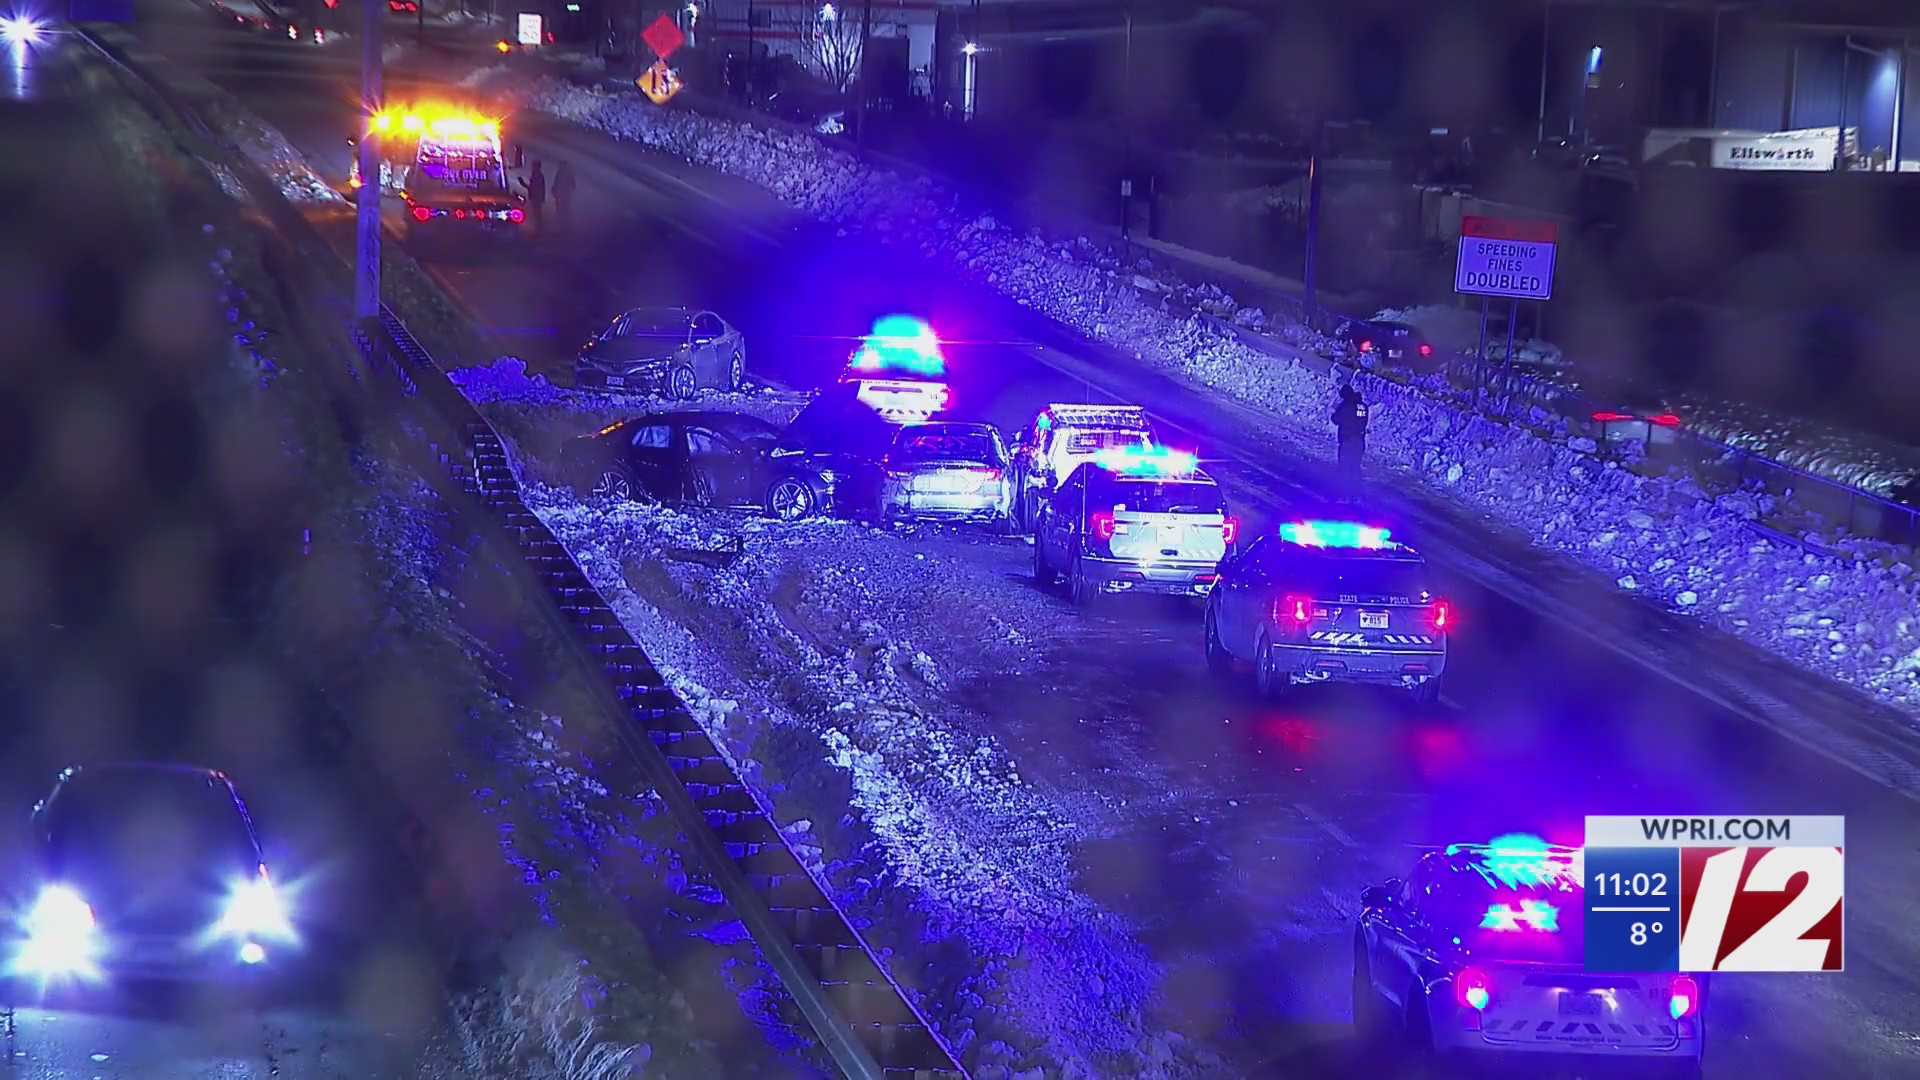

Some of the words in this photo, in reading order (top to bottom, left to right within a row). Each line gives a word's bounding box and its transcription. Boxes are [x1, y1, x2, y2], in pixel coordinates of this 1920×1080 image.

[1478, 243, 1537, 258] SPEEDING
[1487, 258, 1523, 272] FINES
[1466, 271, 1541, 291] DOUBLED
